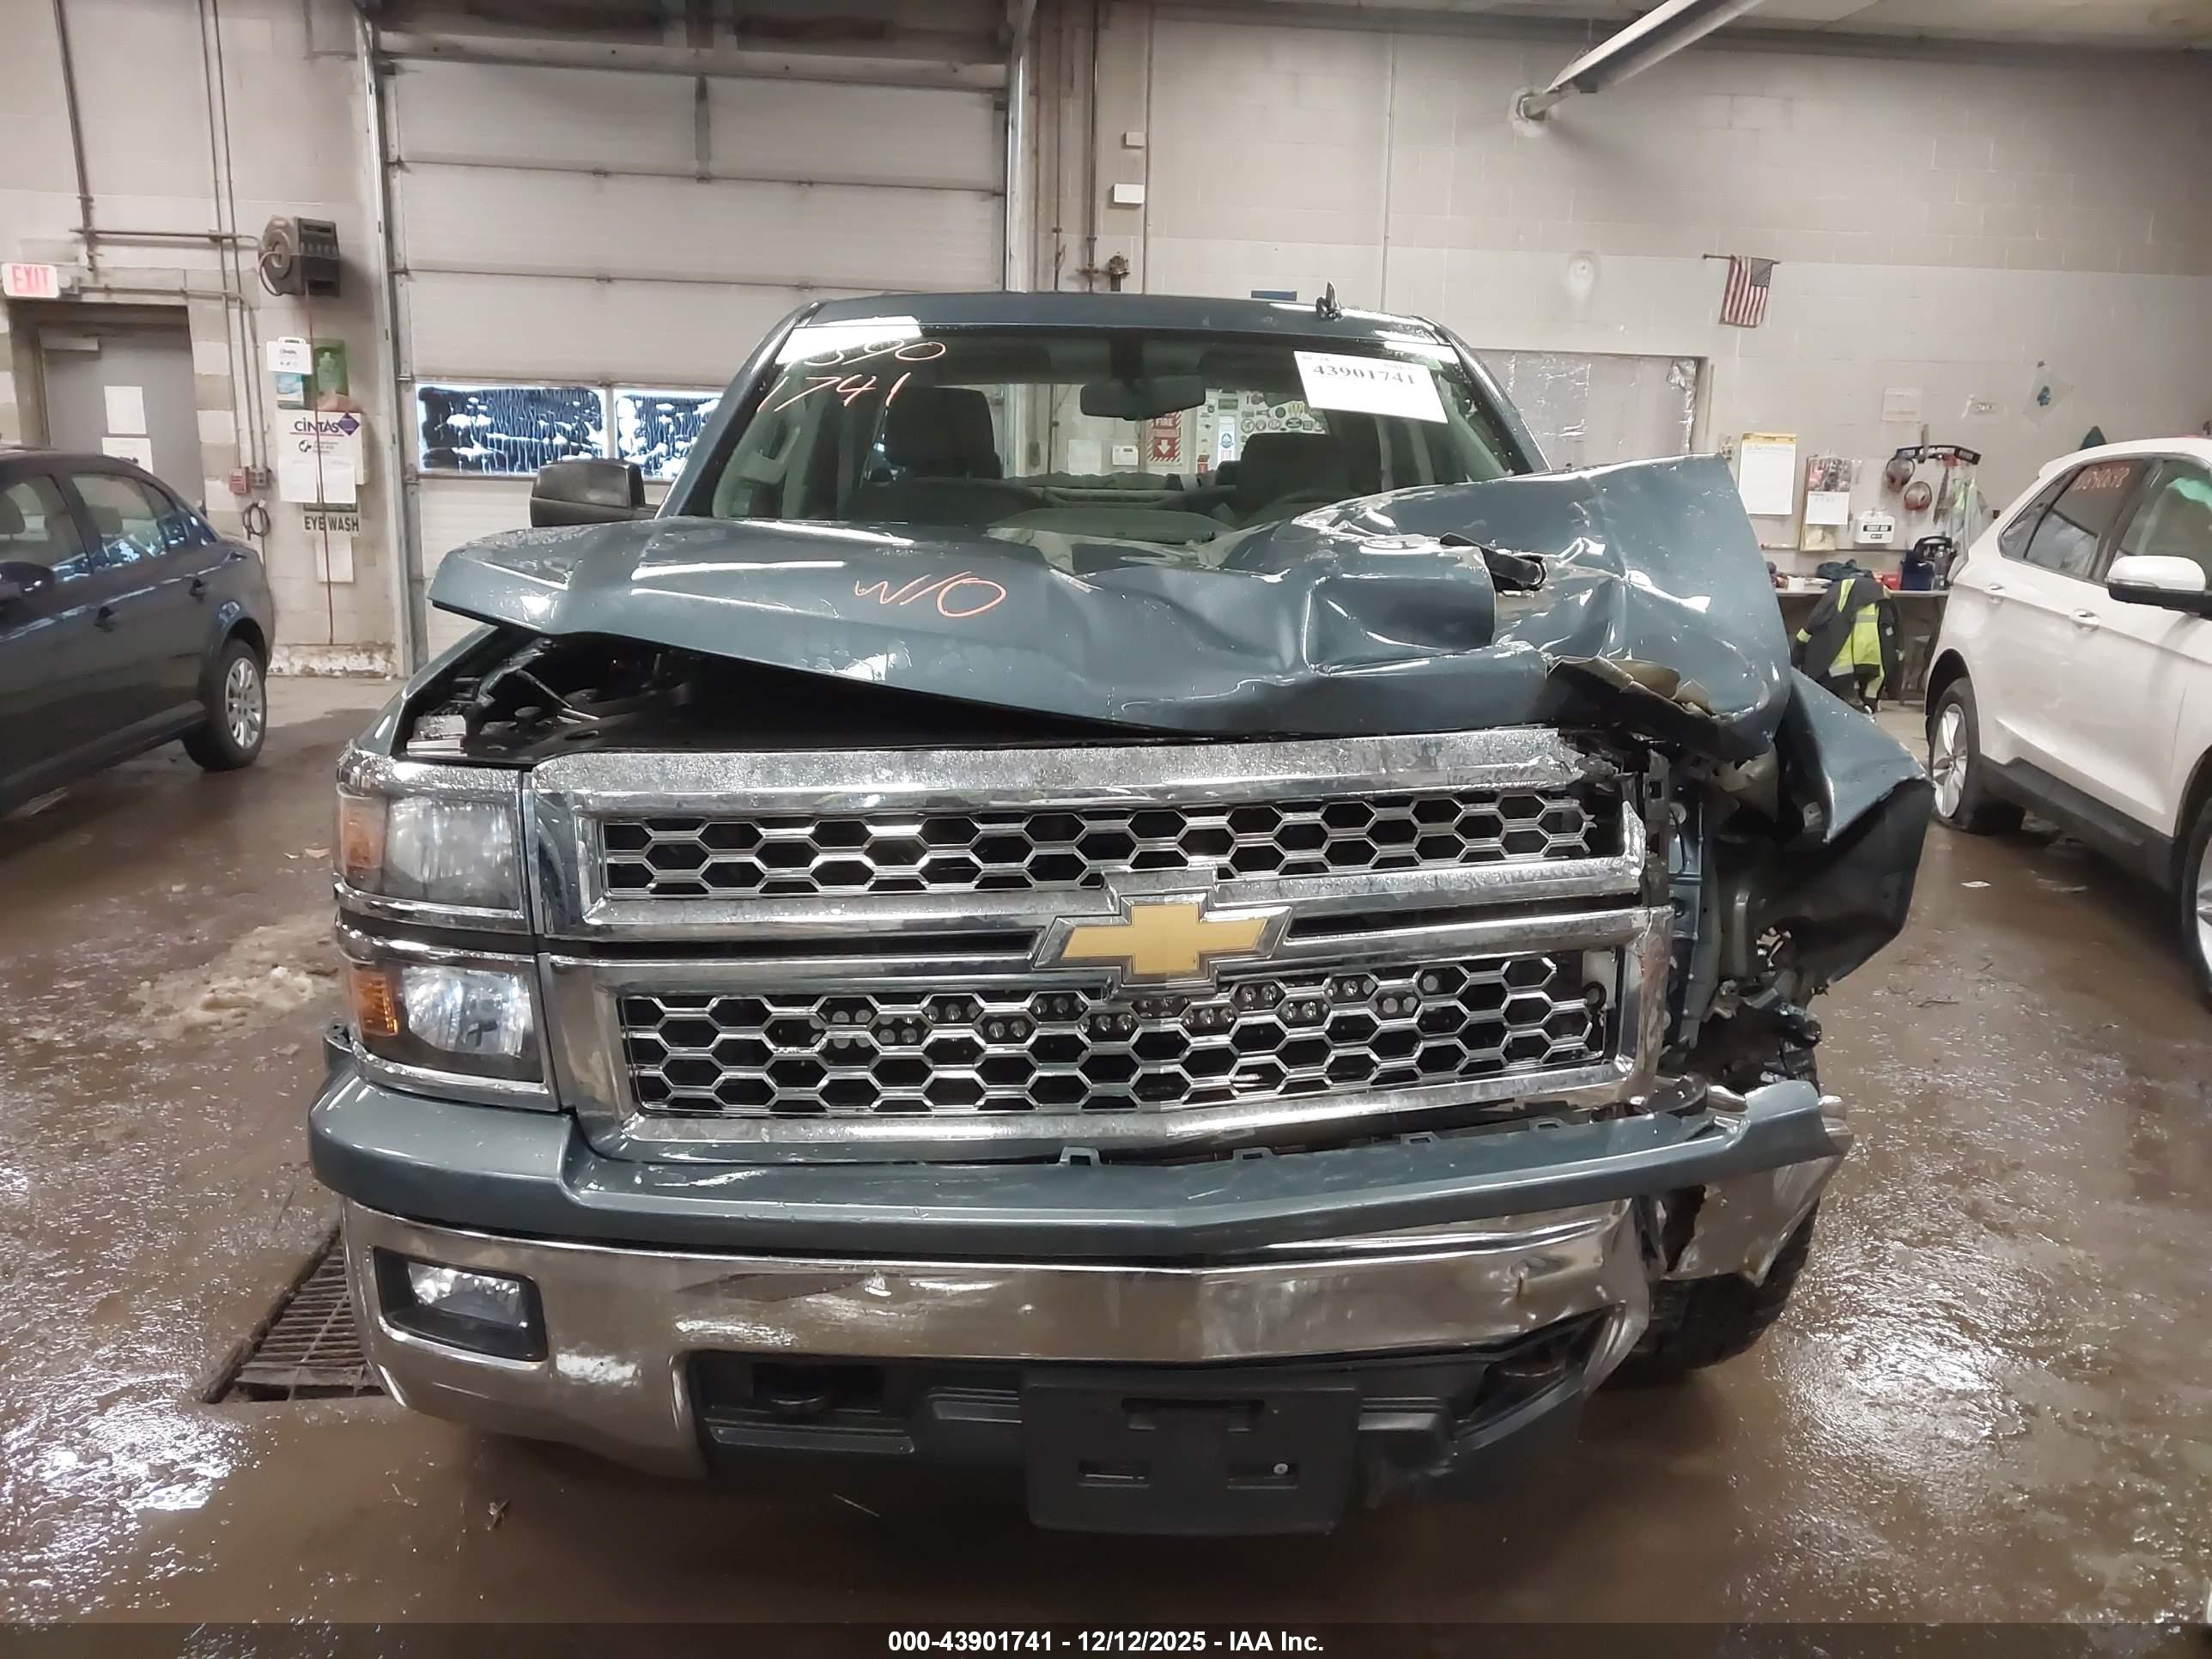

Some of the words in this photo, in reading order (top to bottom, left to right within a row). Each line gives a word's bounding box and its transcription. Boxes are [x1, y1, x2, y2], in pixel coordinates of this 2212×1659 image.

[12, 266, 49, 293] EXIT
[1313, 365, 1416, 385] 43901741
[757, 372, 912, 413] 1741
[294, 417, 340, 434] CINTAS
[1155, 417, 1175, 427] FIRE
[304, 516, 325, 531] EYE
[327, 517, 359, 532] WASH
